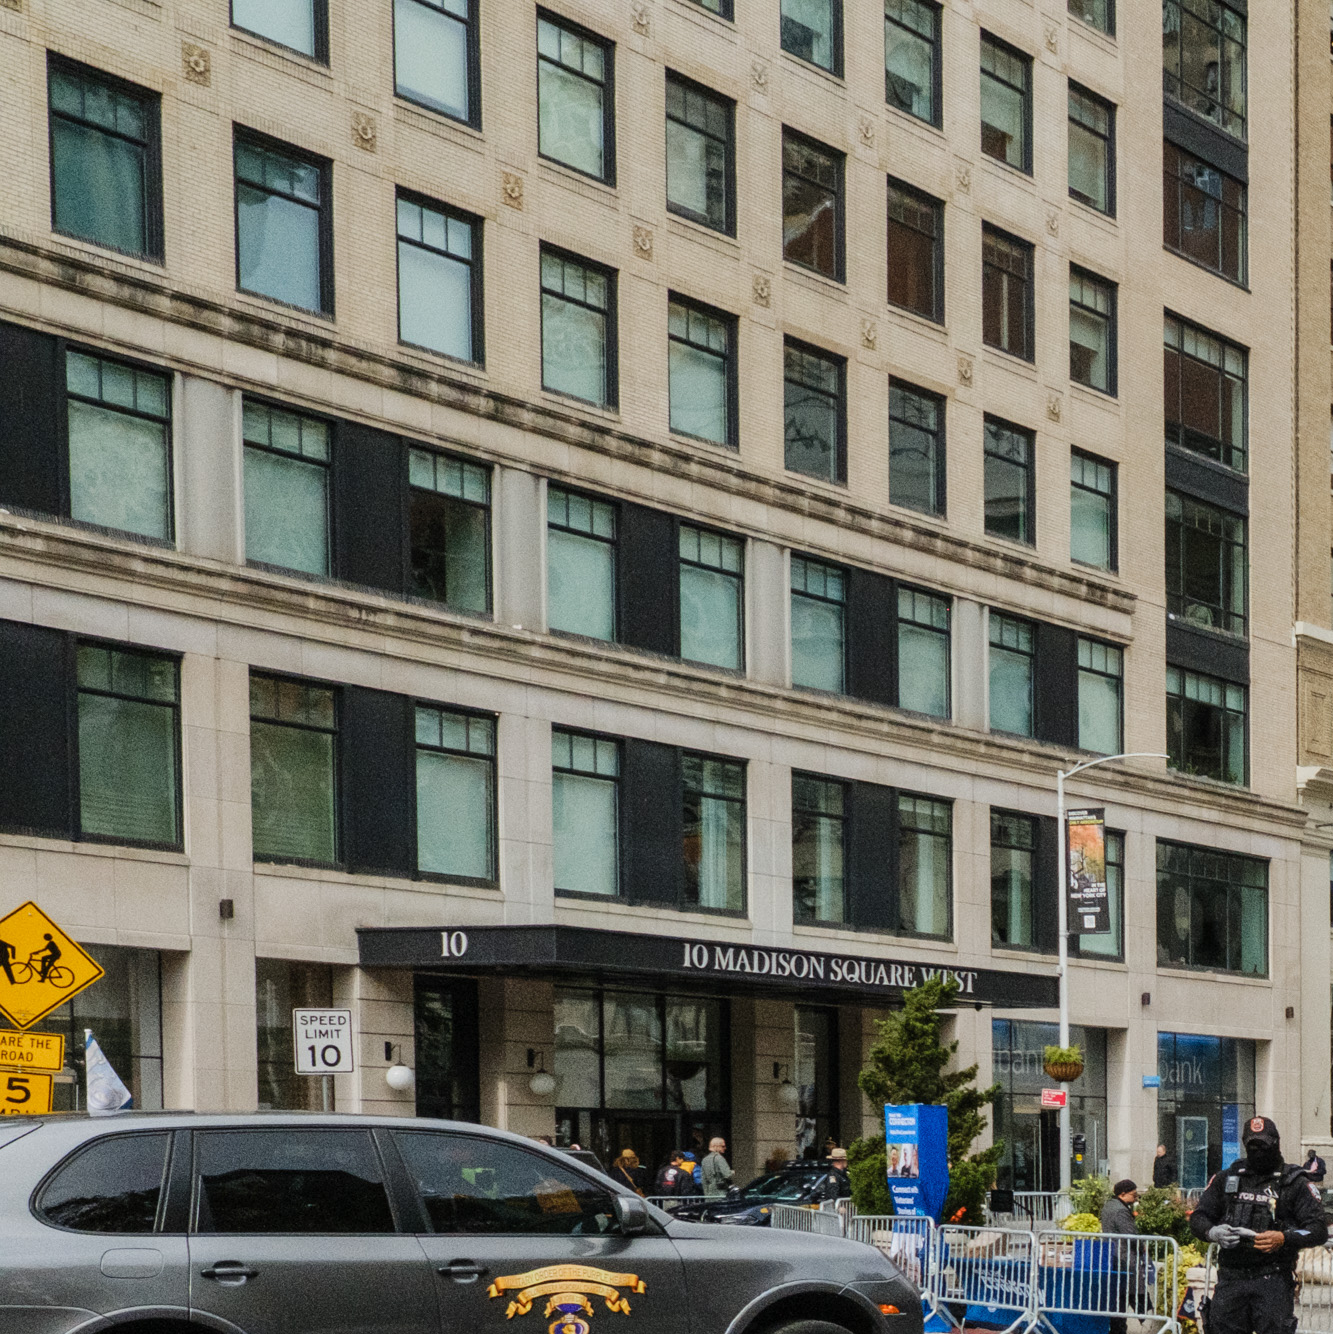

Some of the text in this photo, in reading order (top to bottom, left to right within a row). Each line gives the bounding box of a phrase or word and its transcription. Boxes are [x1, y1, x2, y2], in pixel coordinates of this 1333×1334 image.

[440, 931, 468, 957] 10
[682, 942, 978, 993] 10 MADISON SQUARE WEST
[300, 1015, 346, 1026] SPEED
[0, 1036, 52, 1050] ARE THE
[304, 1028, 342, 1040] LIMIT
[1, 1051, 34, 1063] ROAD
[307, 1044, 342, 1068] 10
[999, 1048, 1045, 1077] ban
[5, 1077, 31, 1104] 5
[535, 1268, 557, 1282] ORDER
[558, 1267, 568, 1277] OF
[568, 1267, 582, 1278] THE
[583, 1268, 609, 1283] PURPLE
